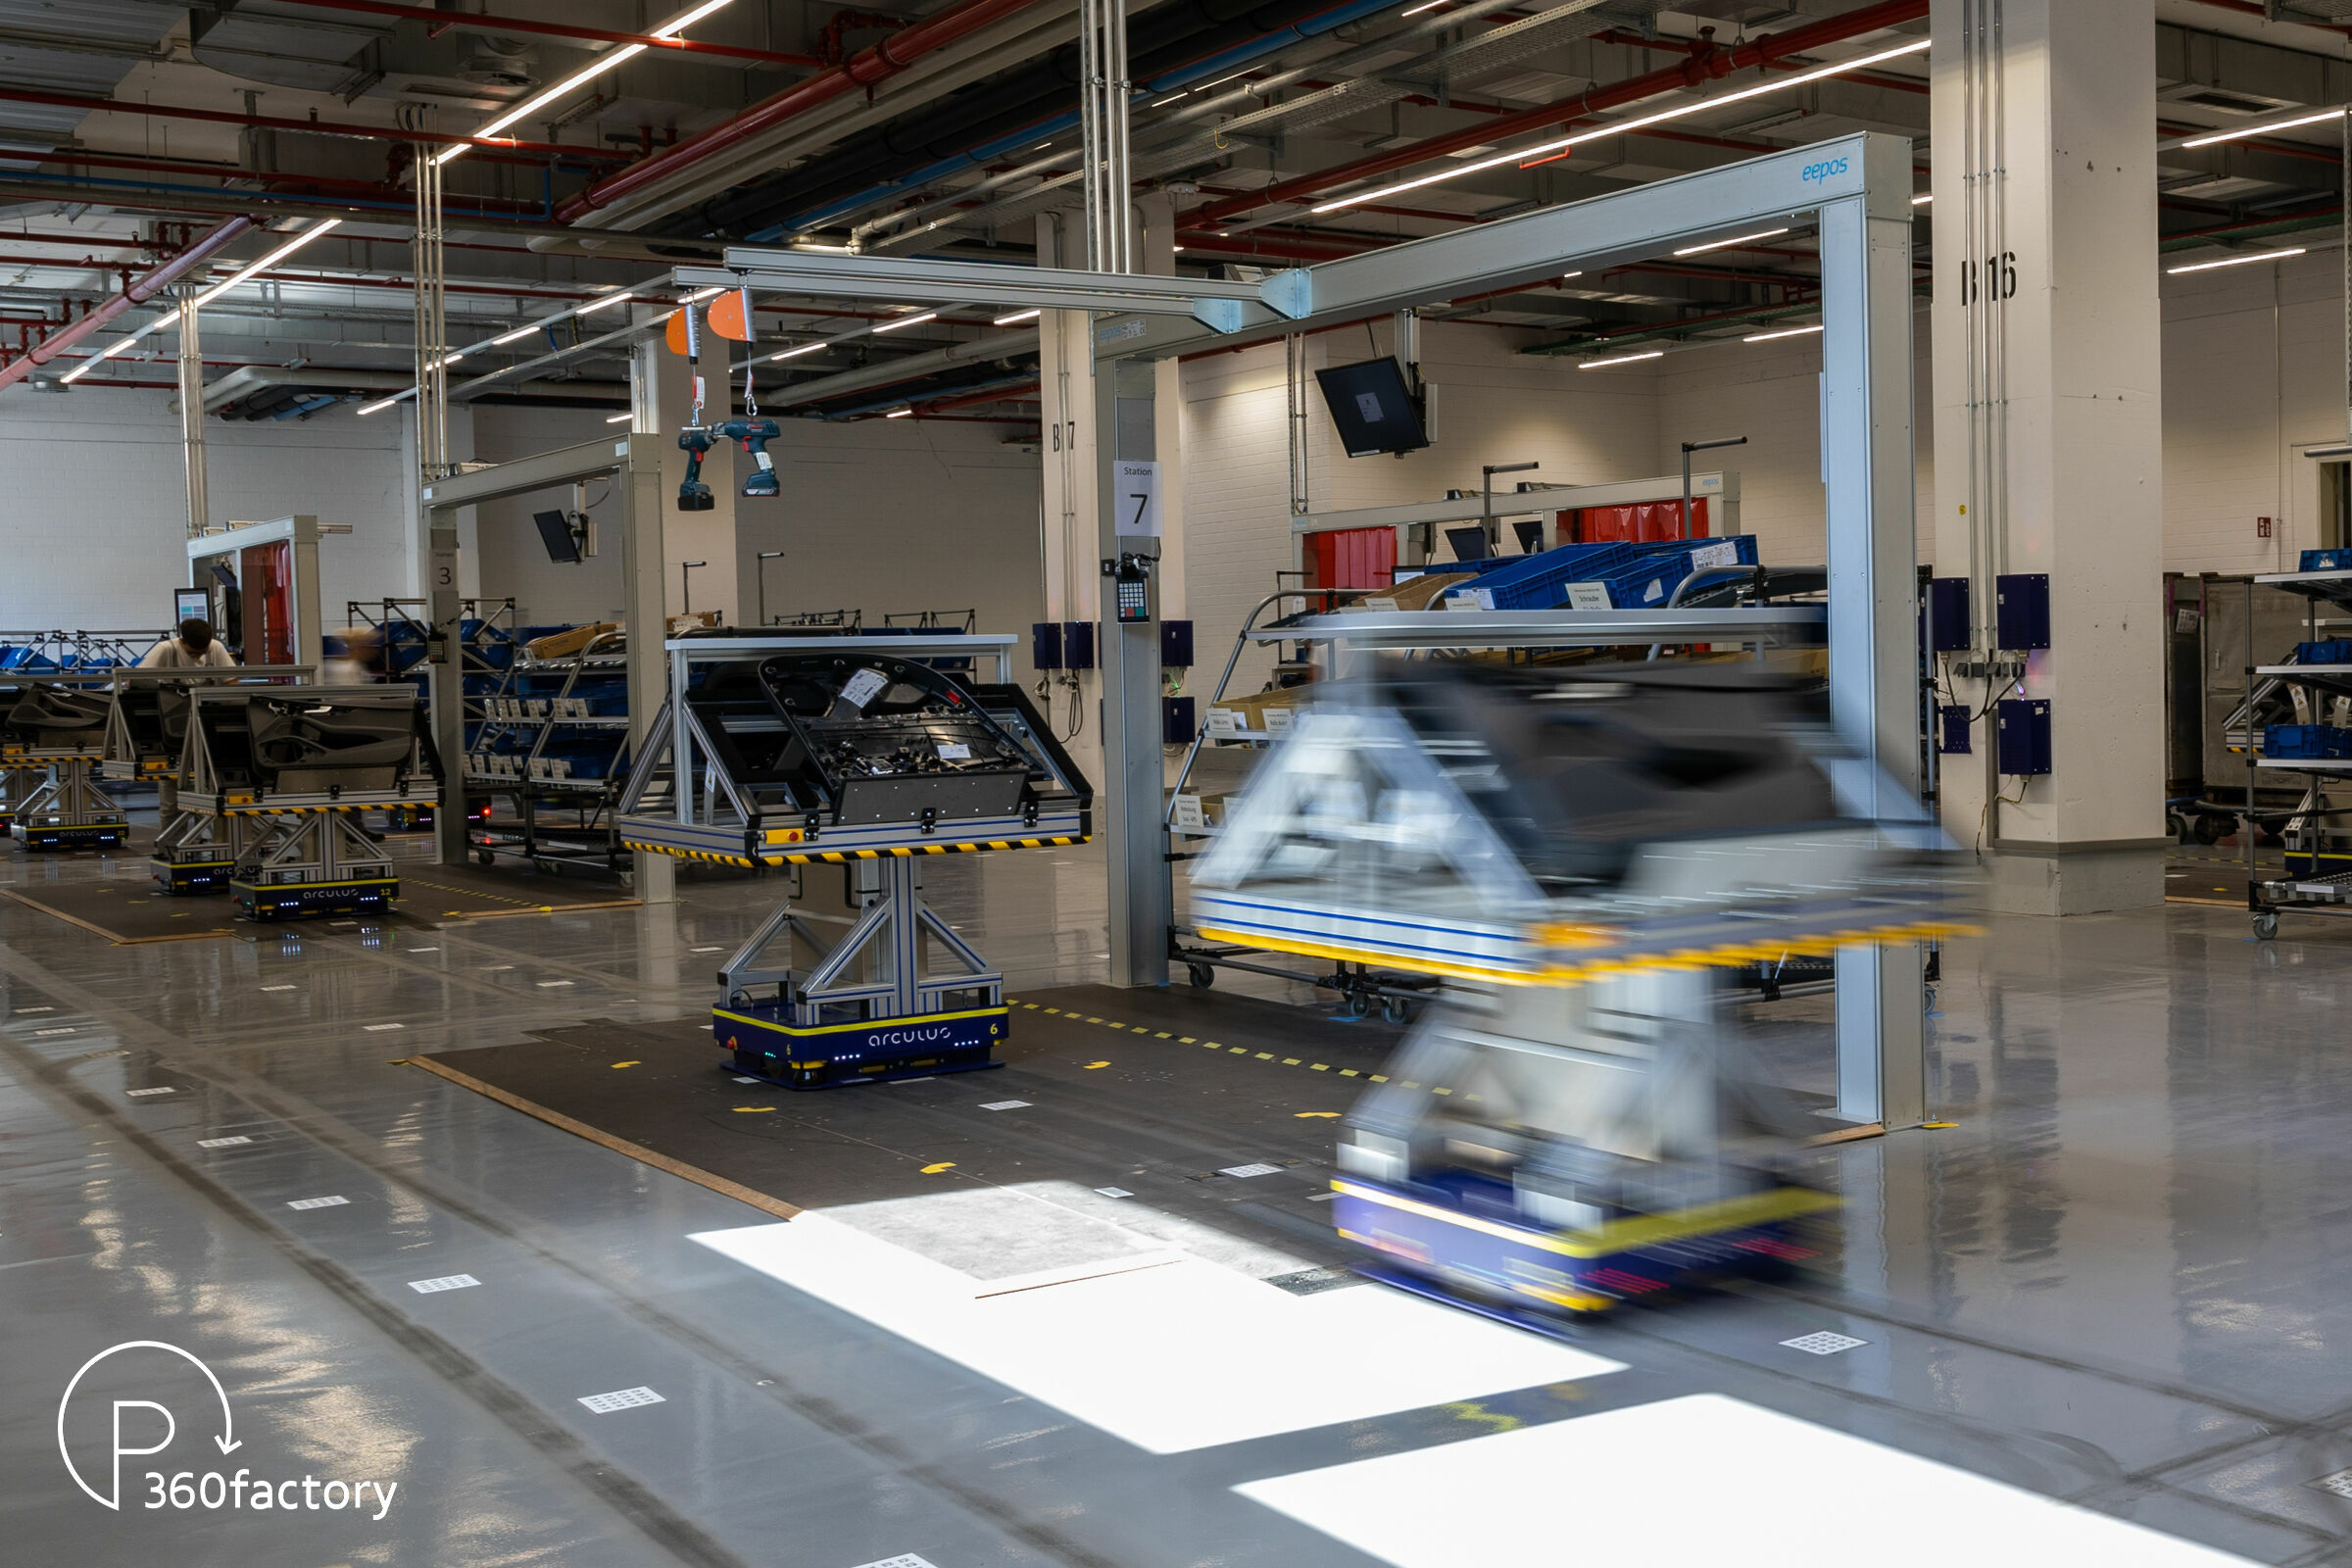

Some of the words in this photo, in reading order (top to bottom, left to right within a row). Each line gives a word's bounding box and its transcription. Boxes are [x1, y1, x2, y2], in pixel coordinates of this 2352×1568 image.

[1802, 157, 1848, 185] eepos
[1962, 260, 1977, 306] B
[1988, 251, 2016, 301] 16
[1054, 423, 1059, 452] B
[1124, 466, 1152, 476] Station
[1130, 494, 1148, 523] 7
[439, 566, 451, 585] 3
[303, 889, 359, 899] arculus
[868, 1027, 951, 1047] arculus
[990, 1023, 999, 1035] 6
